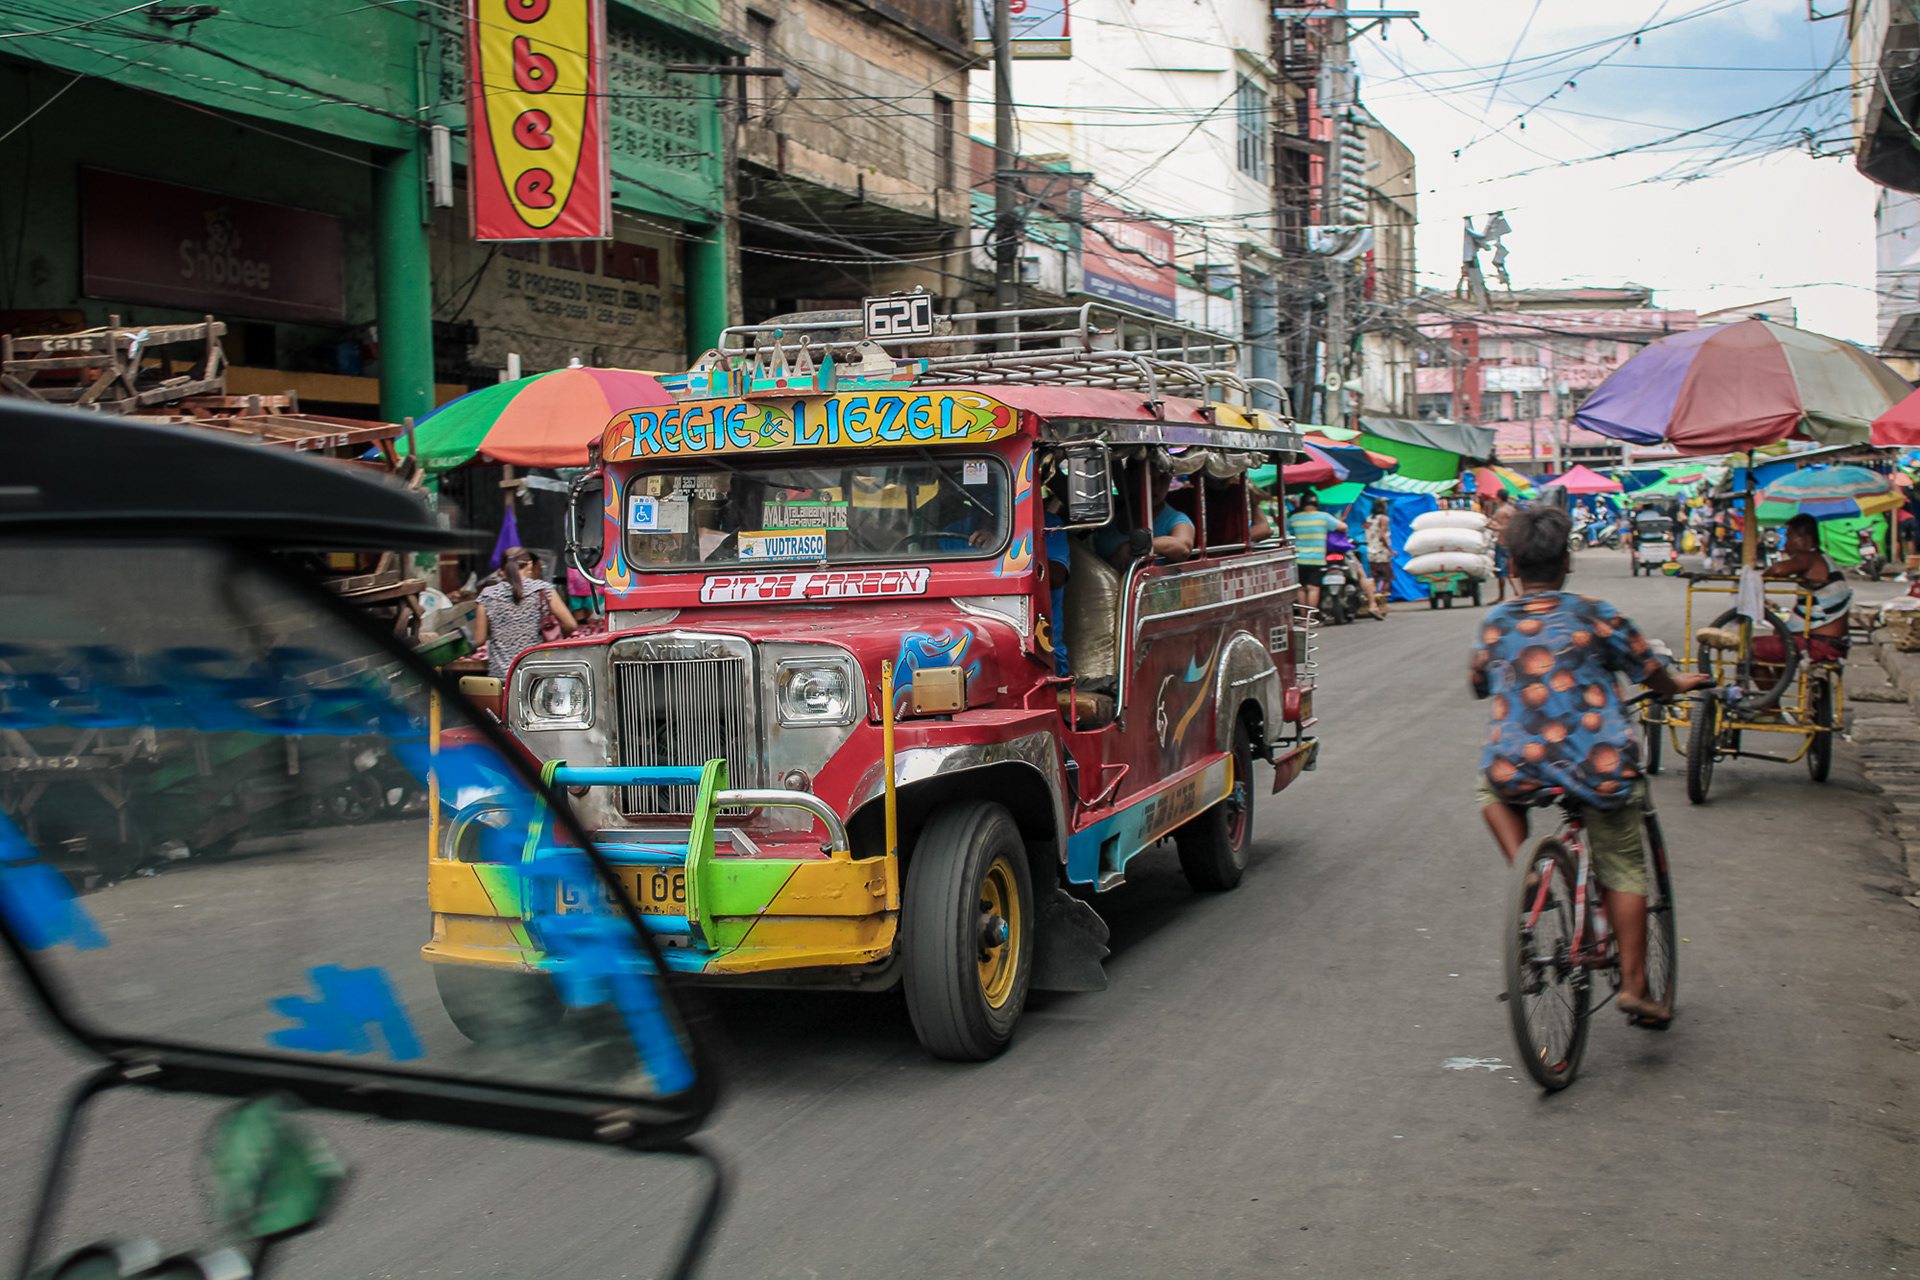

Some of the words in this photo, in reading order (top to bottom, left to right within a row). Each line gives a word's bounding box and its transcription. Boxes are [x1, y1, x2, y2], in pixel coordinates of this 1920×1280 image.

[179, 238, 271, 290] Shobee
[869, 299, 930, 335] 62C
[41, 338, 94, 352] CRIS
[629, 404, 751, 457] REGIE
[759, 411, 789, 438] &
[792, 396, 972, 446] LIEZEL
[764, 535, 824, 556] VUDTRASCO
[804, 570, 921, 597] CARBON
